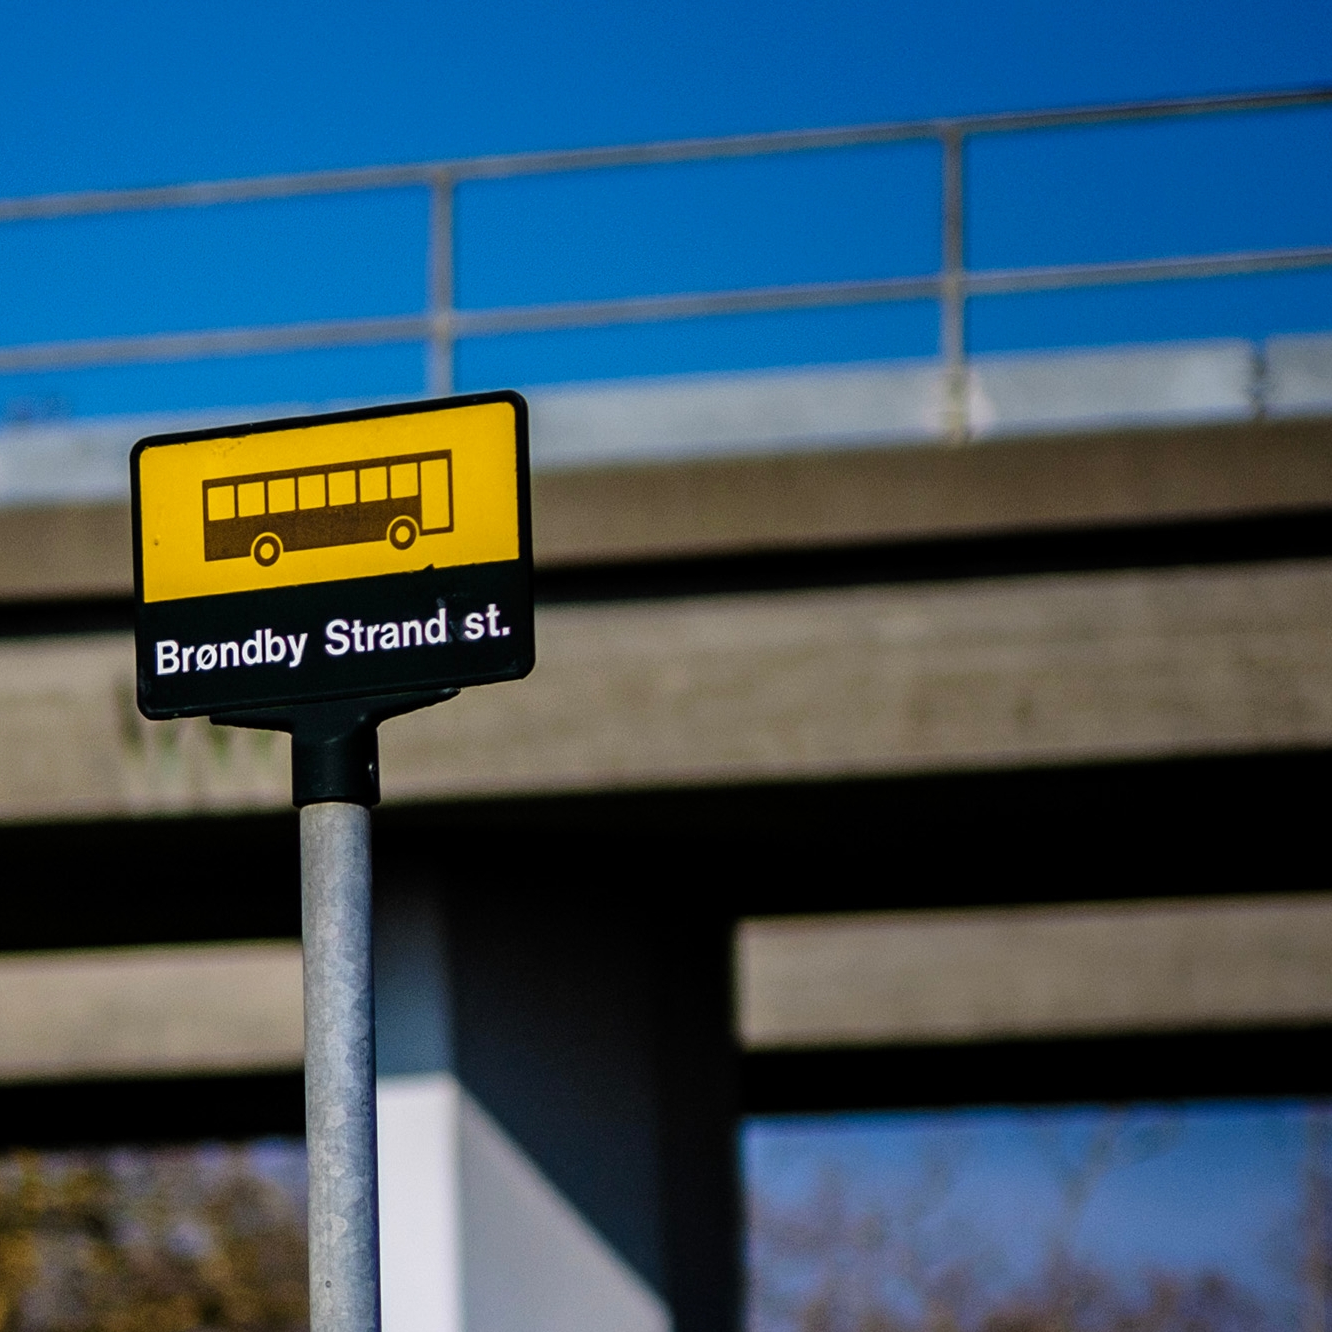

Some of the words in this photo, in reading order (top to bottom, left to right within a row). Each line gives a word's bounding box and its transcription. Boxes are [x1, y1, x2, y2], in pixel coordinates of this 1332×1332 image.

[155, 628, 308, 676] Brøndby
[324, 608, 448, 657] Strand
[463, 603, 511, 641] st.
